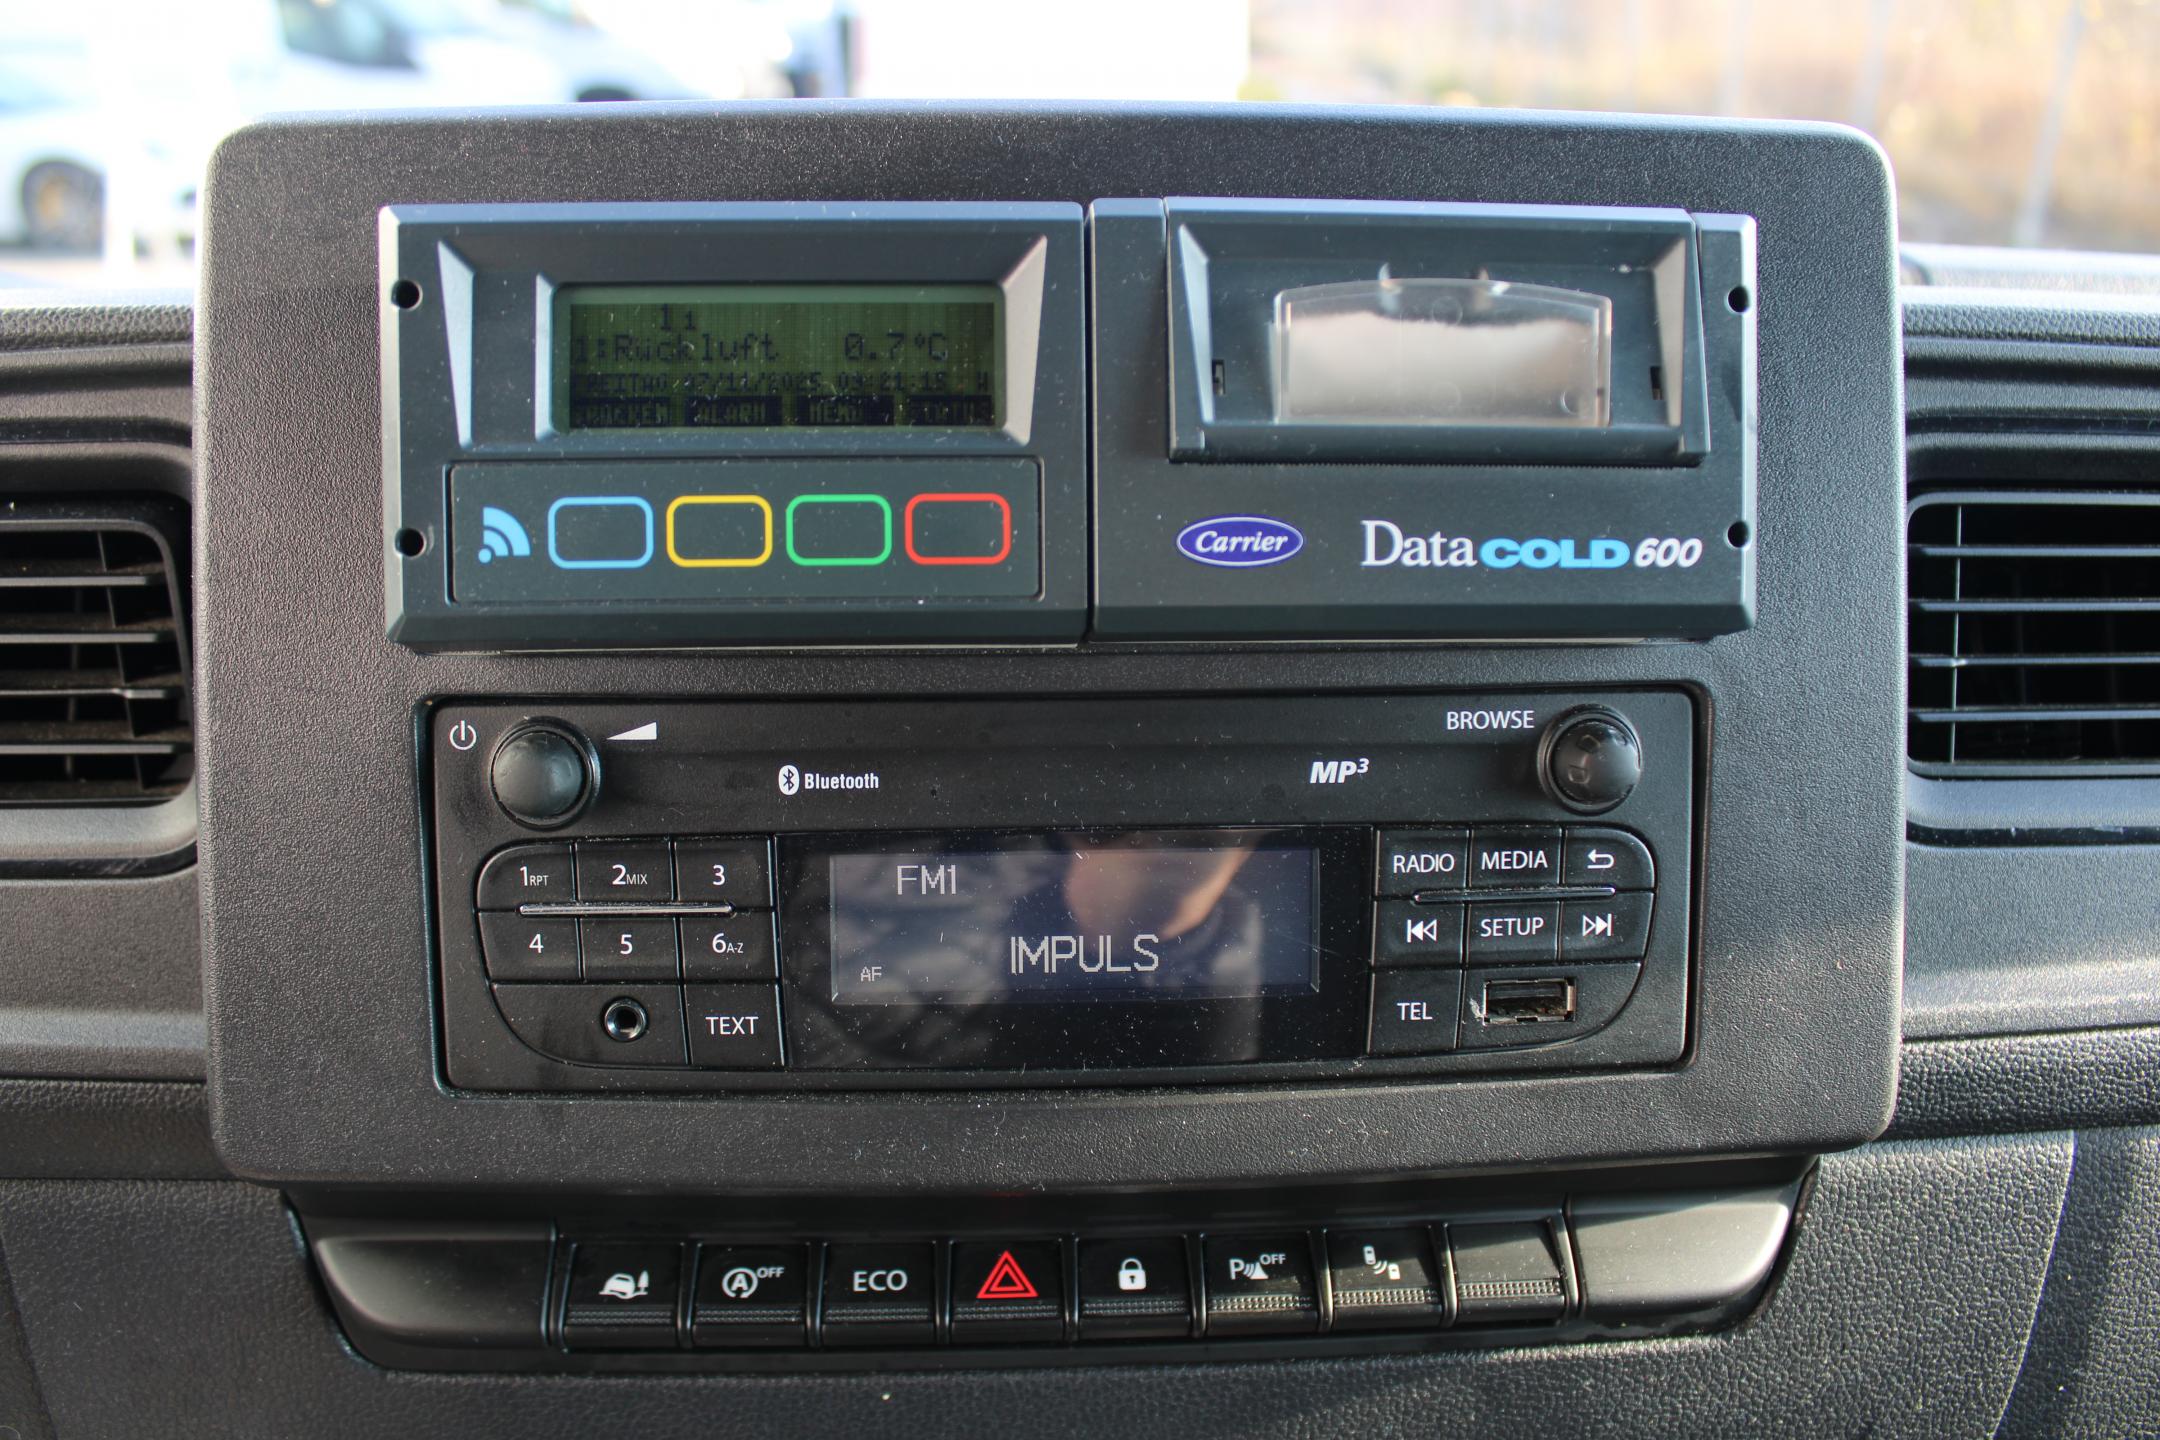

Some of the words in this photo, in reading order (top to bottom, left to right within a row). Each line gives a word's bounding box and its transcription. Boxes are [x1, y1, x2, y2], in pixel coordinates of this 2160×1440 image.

[1195, 527, 1288, 555] Carrier
[1446, 710, 1535, 730] BROWSE
[804, 772, 880, 790] Bluetooth
[1392, 853, 1455, 874] RADIO
[1481, 850, 1548, 870] MEDIA
[712, 864, 726, 886] 3
[896, 864, 957, 895] FM1
[1480, 916, 1544, 938] SETUP
[528, 933, 544, 954] 4
[620, 933, 633, 955] 5
[1010, 933, 1159, 975] IMPULS
[860, 966, 882, 982] AF
[1396, 1001, 1433, 1021] TEL
[705, 1016, 759, 1035] TEXT
[757, 1266, 785, 1279] OFF
[1229, 1258, 1244, 1280] P
[1259, 1253, 1286, 1266] OFF
[853, 1269, 908, 1292] ECO
